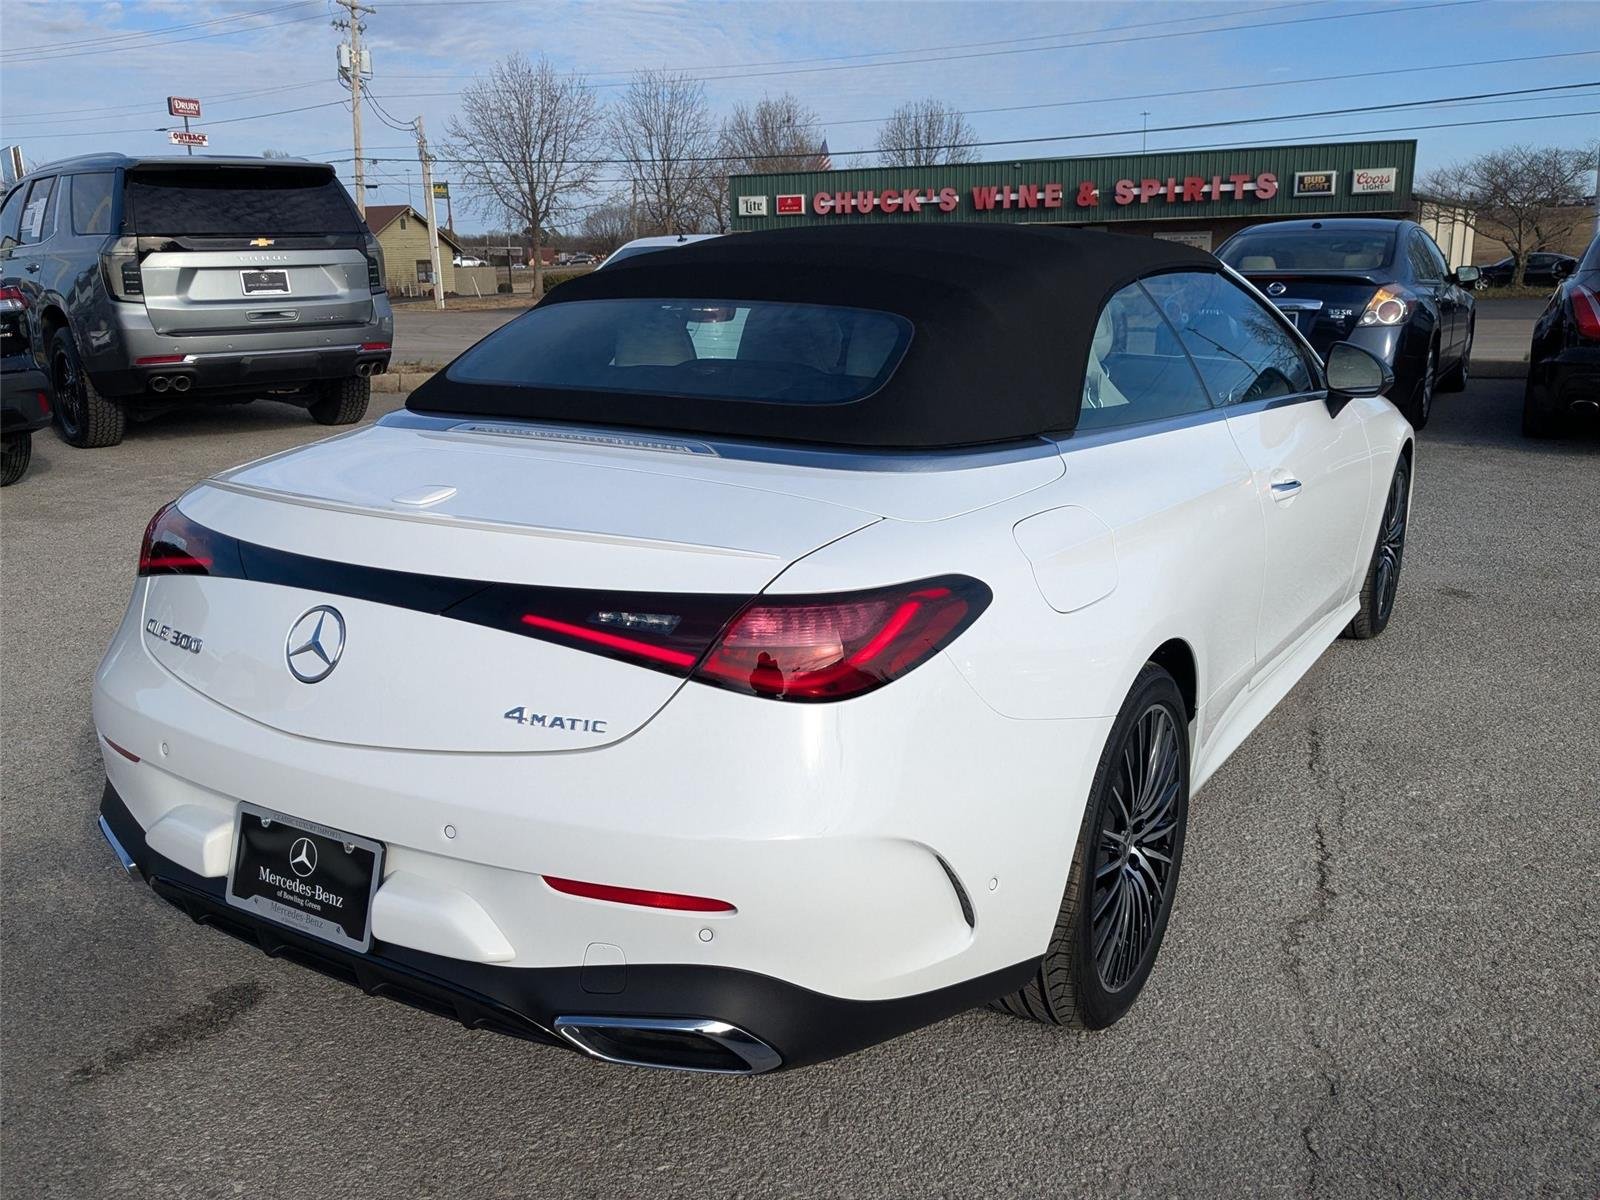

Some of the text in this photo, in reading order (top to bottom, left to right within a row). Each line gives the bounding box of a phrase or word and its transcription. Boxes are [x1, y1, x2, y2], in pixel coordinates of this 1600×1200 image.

[175, 100, 198, 110] DRURY
[173, 133, 206, 141] OUTBACK
[1300, 183, 1330, 191] LIGHT
[1304, 176, 1326, 184] BUD
[1357, 172, 1390, 185] Coors
[813, 172, 1277, 215] CHUCK'S WINE & SPIRITS
[745, 200, 762, 213] Lite
[170, 630, 203, 654] 300
[503, 706, 608, 734] 4MATIC
[258, 866, 344, 908] Mercedes-Benz
[276, 889, 321, 912] of Bowling Green
[270, 901, 324, 929] Mercedes-Benz
